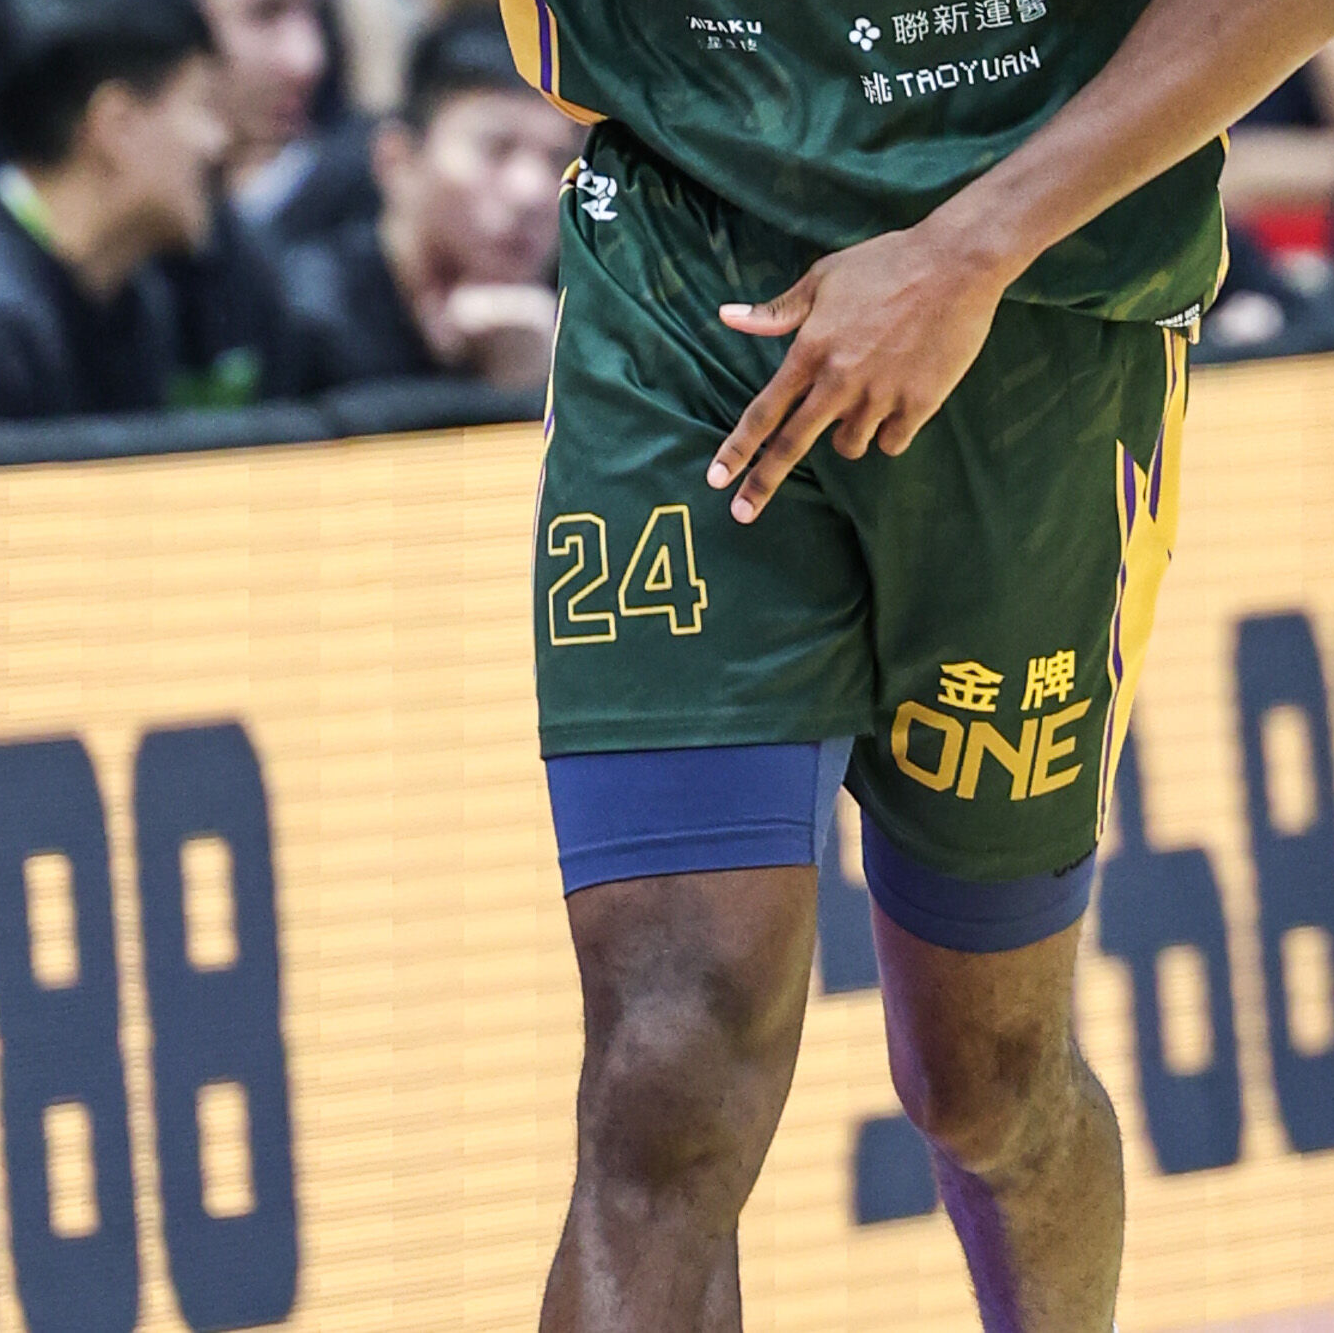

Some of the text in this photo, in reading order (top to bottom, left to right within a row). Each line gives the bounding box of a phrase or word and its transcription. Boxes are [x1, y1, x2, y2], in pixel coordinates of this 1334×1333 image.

[896, 45, 1042, 98] TAOYUAN
[547, 504, 708, 647] 24
[937, 650, 1076, 713] 金牌
[890, 698, 1092, 801] ONE
